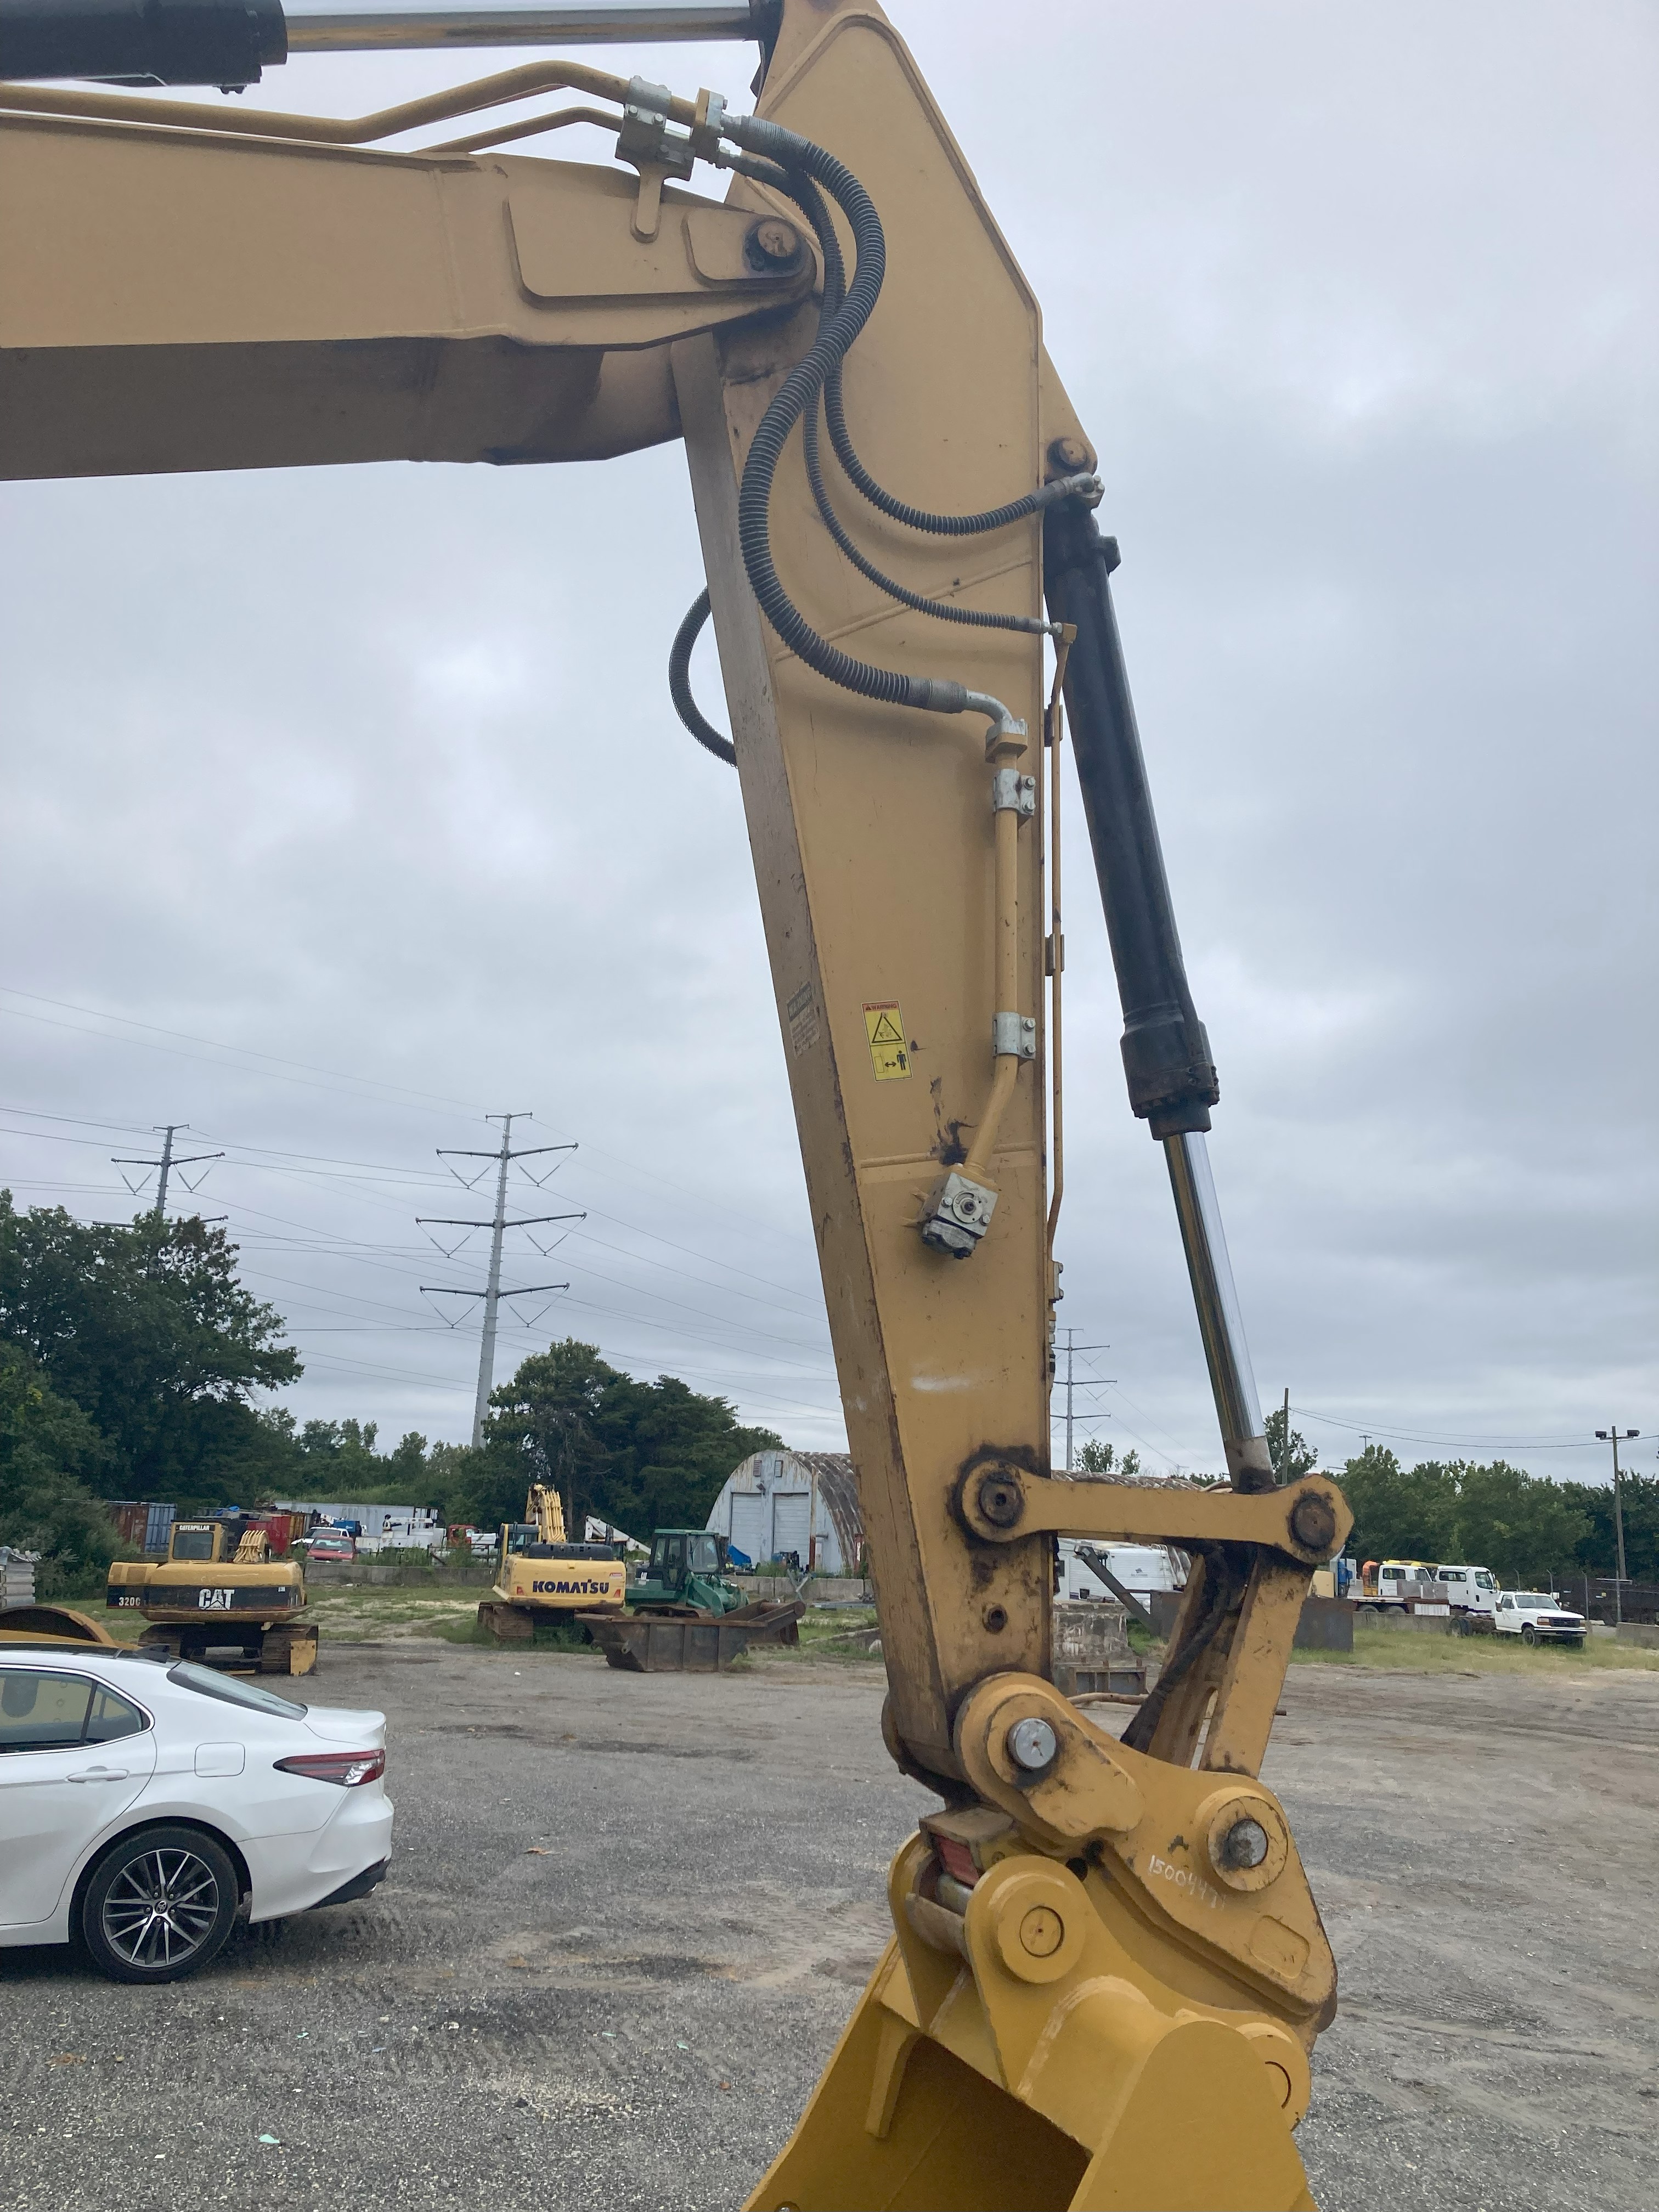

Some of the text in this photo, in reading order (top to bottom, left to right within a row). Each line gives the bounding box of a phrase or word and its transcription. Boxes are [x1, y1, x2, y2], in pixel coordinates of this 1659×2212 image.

[533, 1579, 609, 1594] KOMATSU
[119, 1597, 141, 1606] 320C
[198, 1589, 235, 1610] CAT
